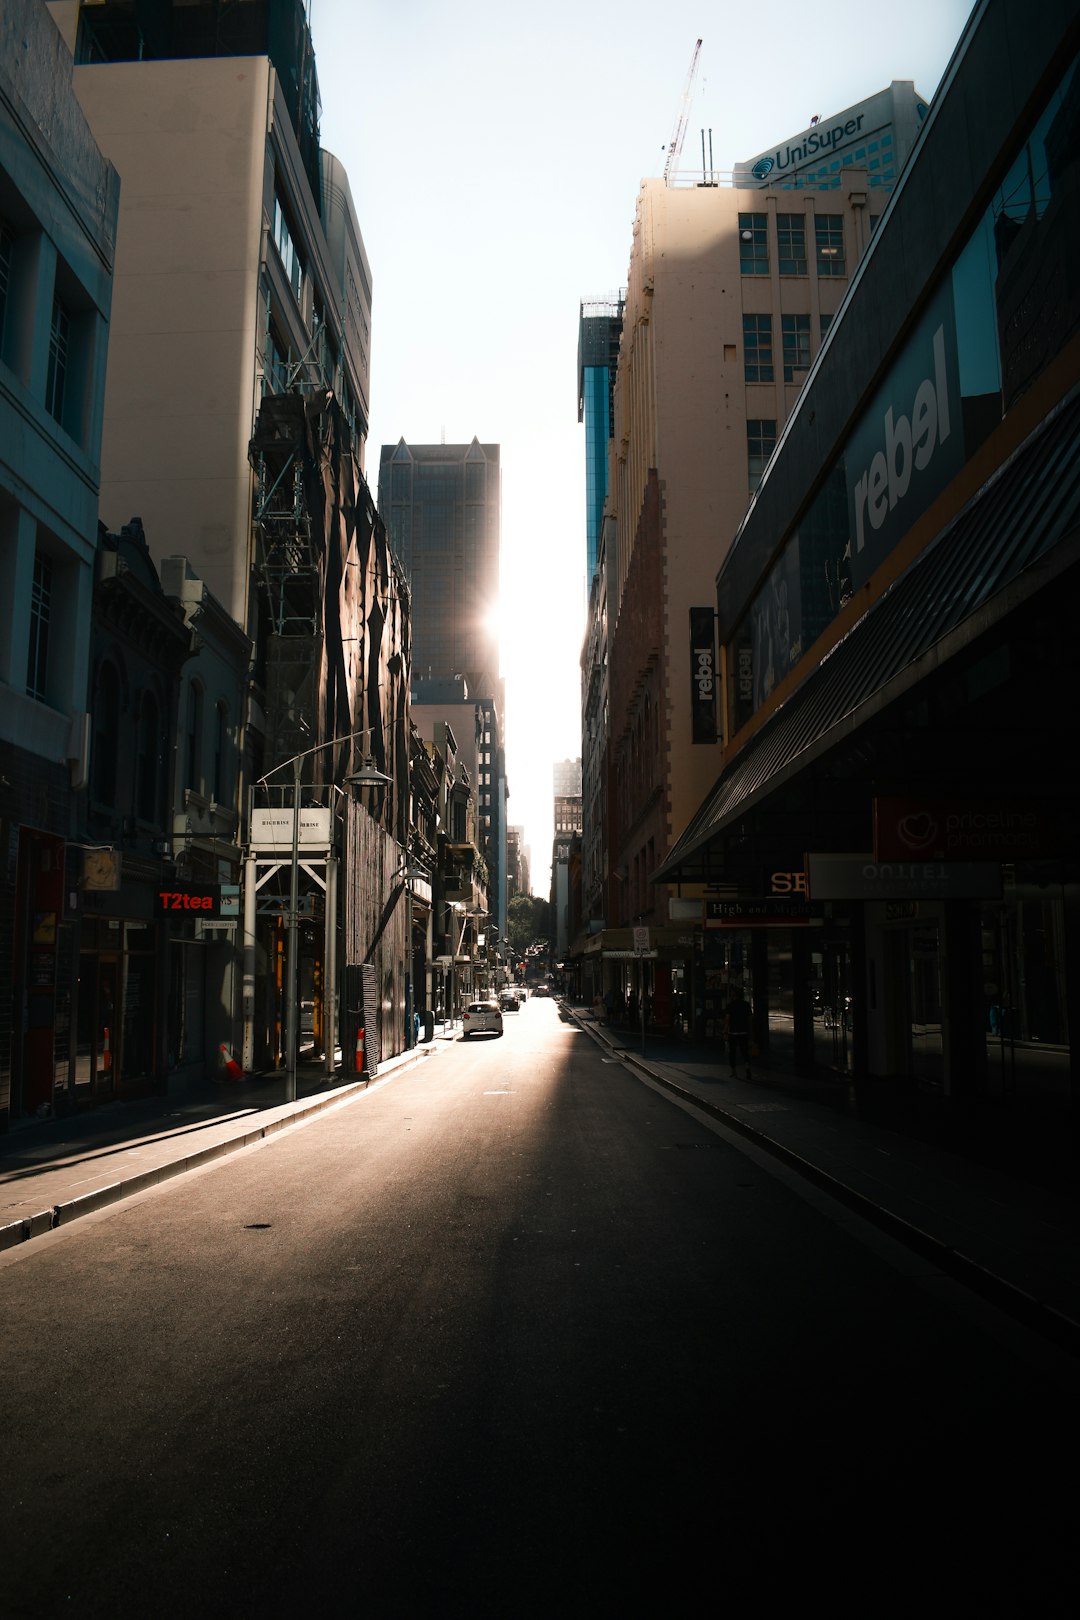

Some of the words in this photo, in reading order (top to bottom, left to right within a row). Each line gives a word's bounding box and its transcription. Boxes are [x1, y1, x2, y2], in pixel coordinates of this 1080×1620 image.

[776, 114, 864, 169] UniSuper
[854, 322, 951, 553] rebel
[694, 648, 713, 701] rebel
[946, 810, 1038, 833] priceline
[159, 891, 214, 911] T2tea
[713, 903, 742, 917] High
[748, 903, 768, 914] and
